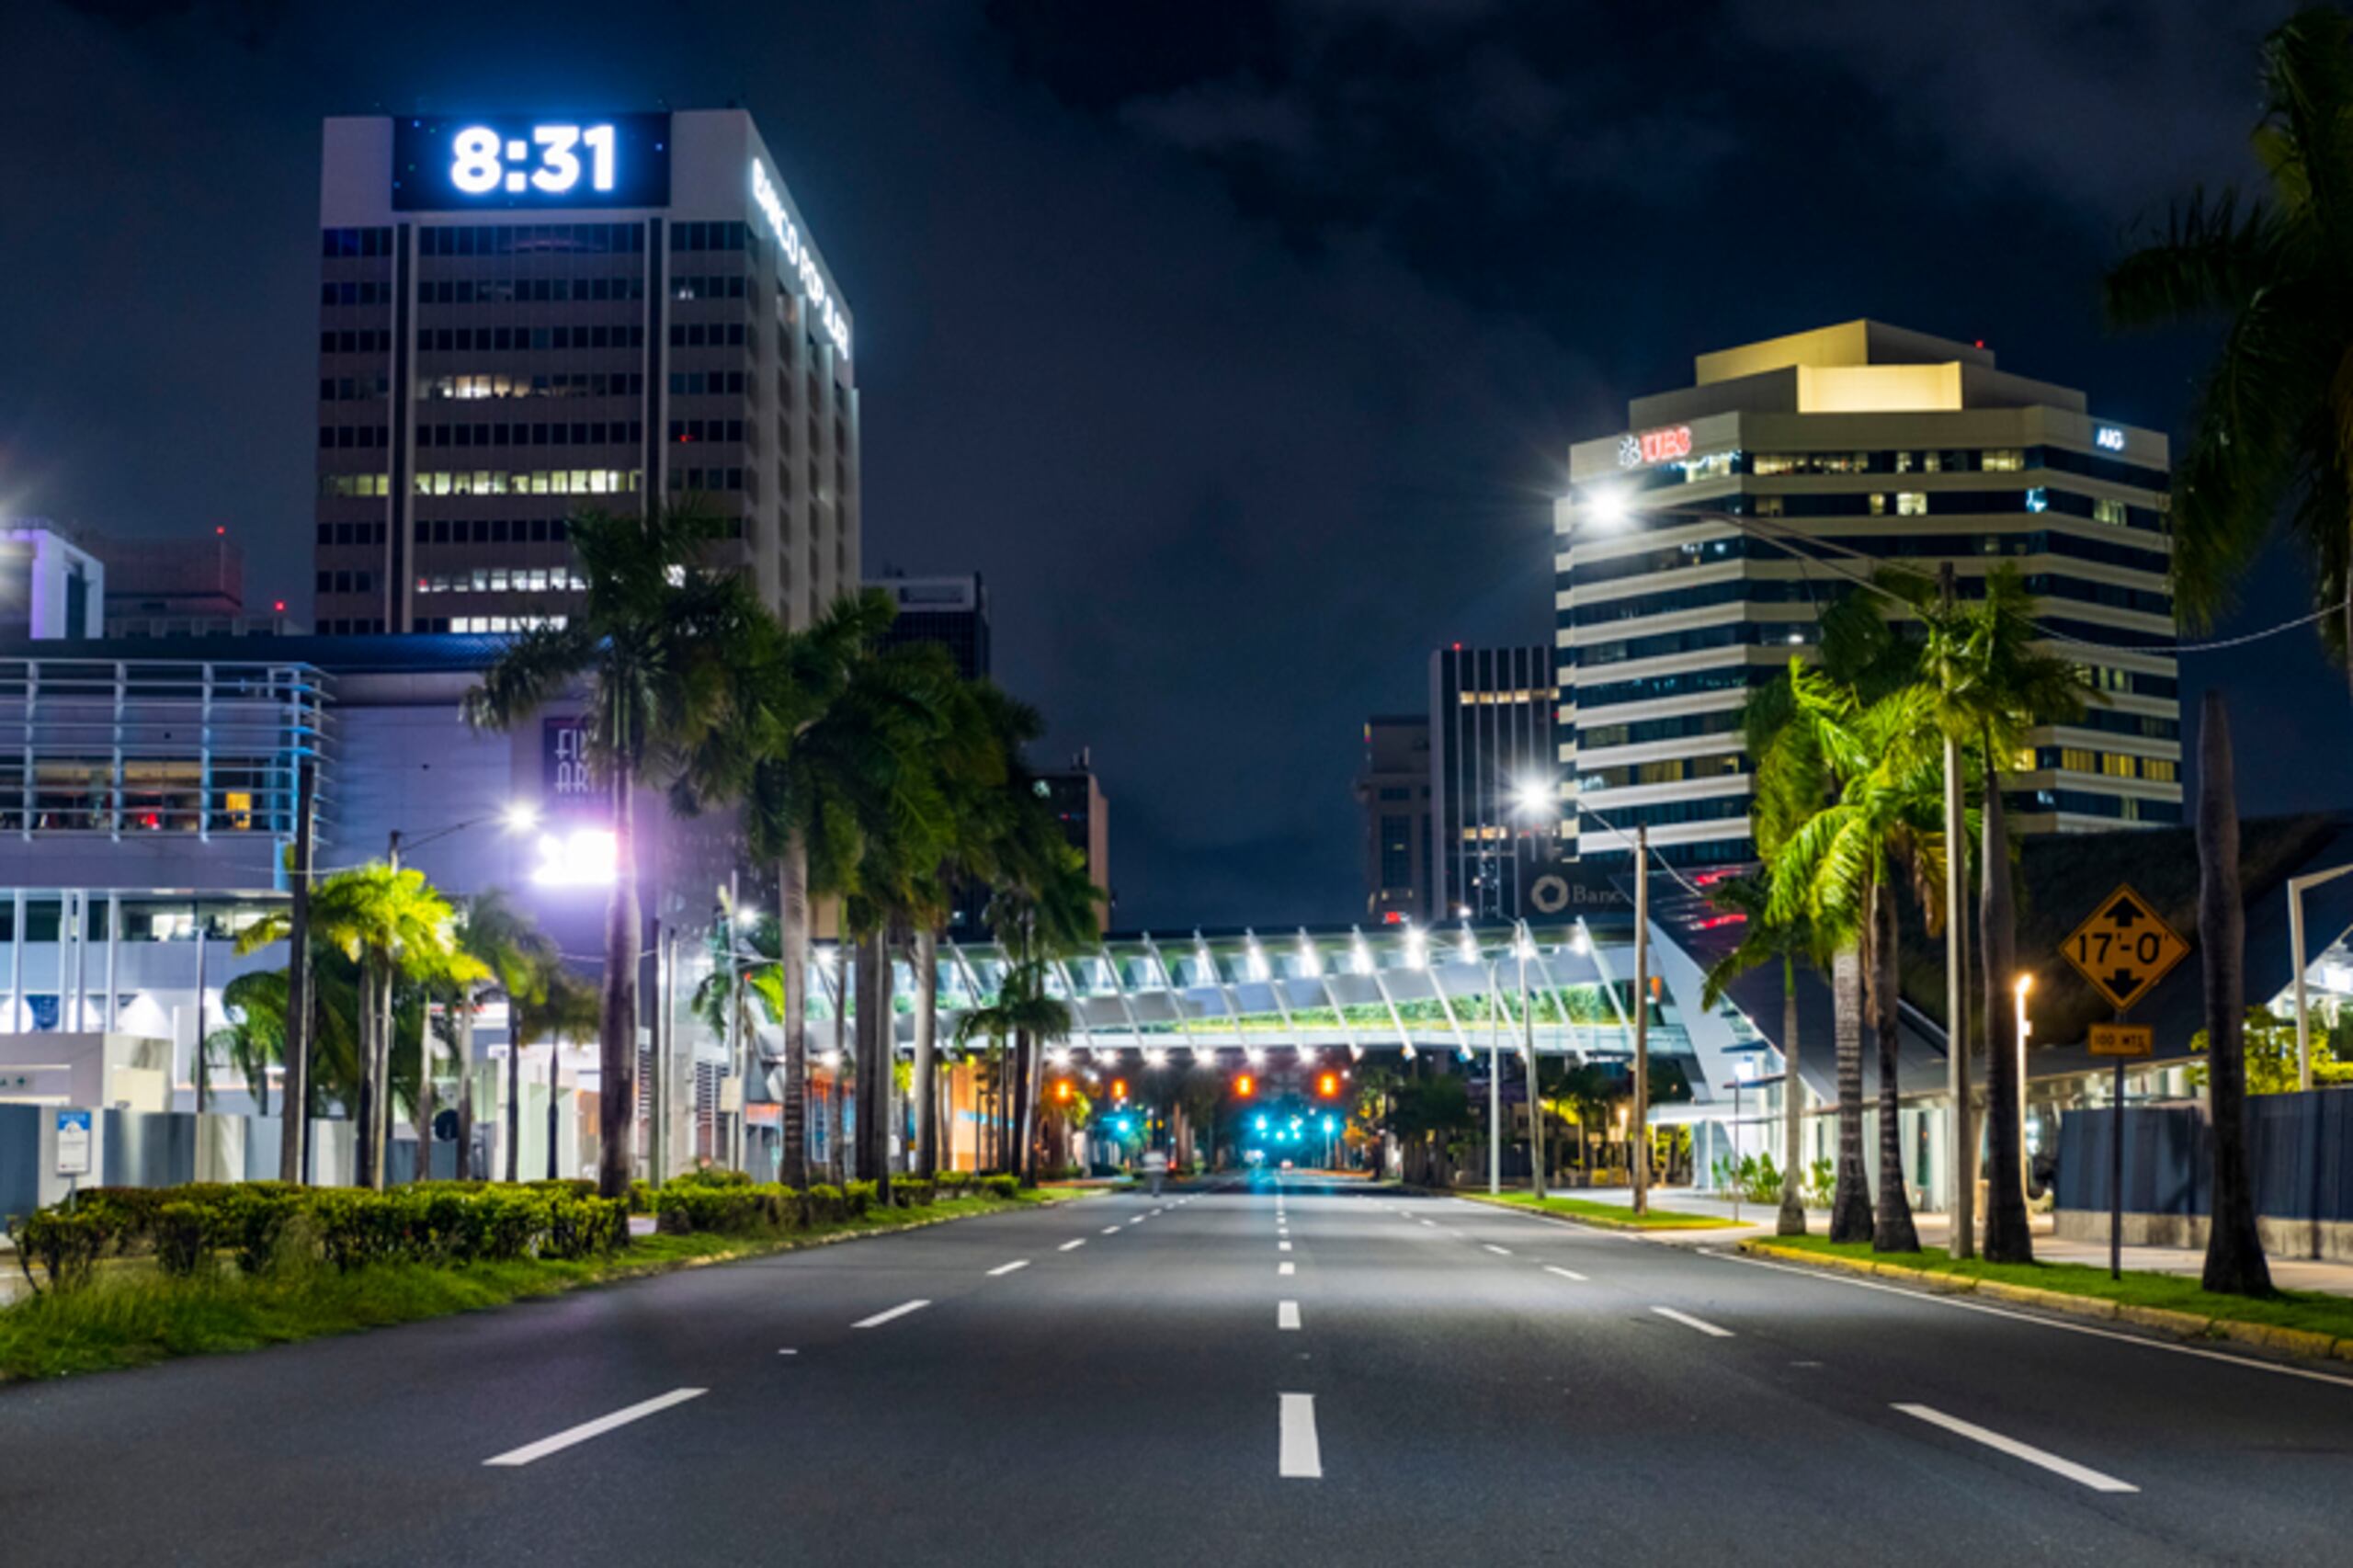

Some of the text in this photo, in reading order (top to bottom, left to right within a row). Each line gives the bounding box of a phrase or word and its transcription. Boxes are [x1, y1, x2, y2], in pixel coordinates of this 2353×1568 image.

[451, 125, 614, 192] 8:31
[1640, 426, 1691, 462] UBS
[2094, 1032, 2115, 1046] 100
